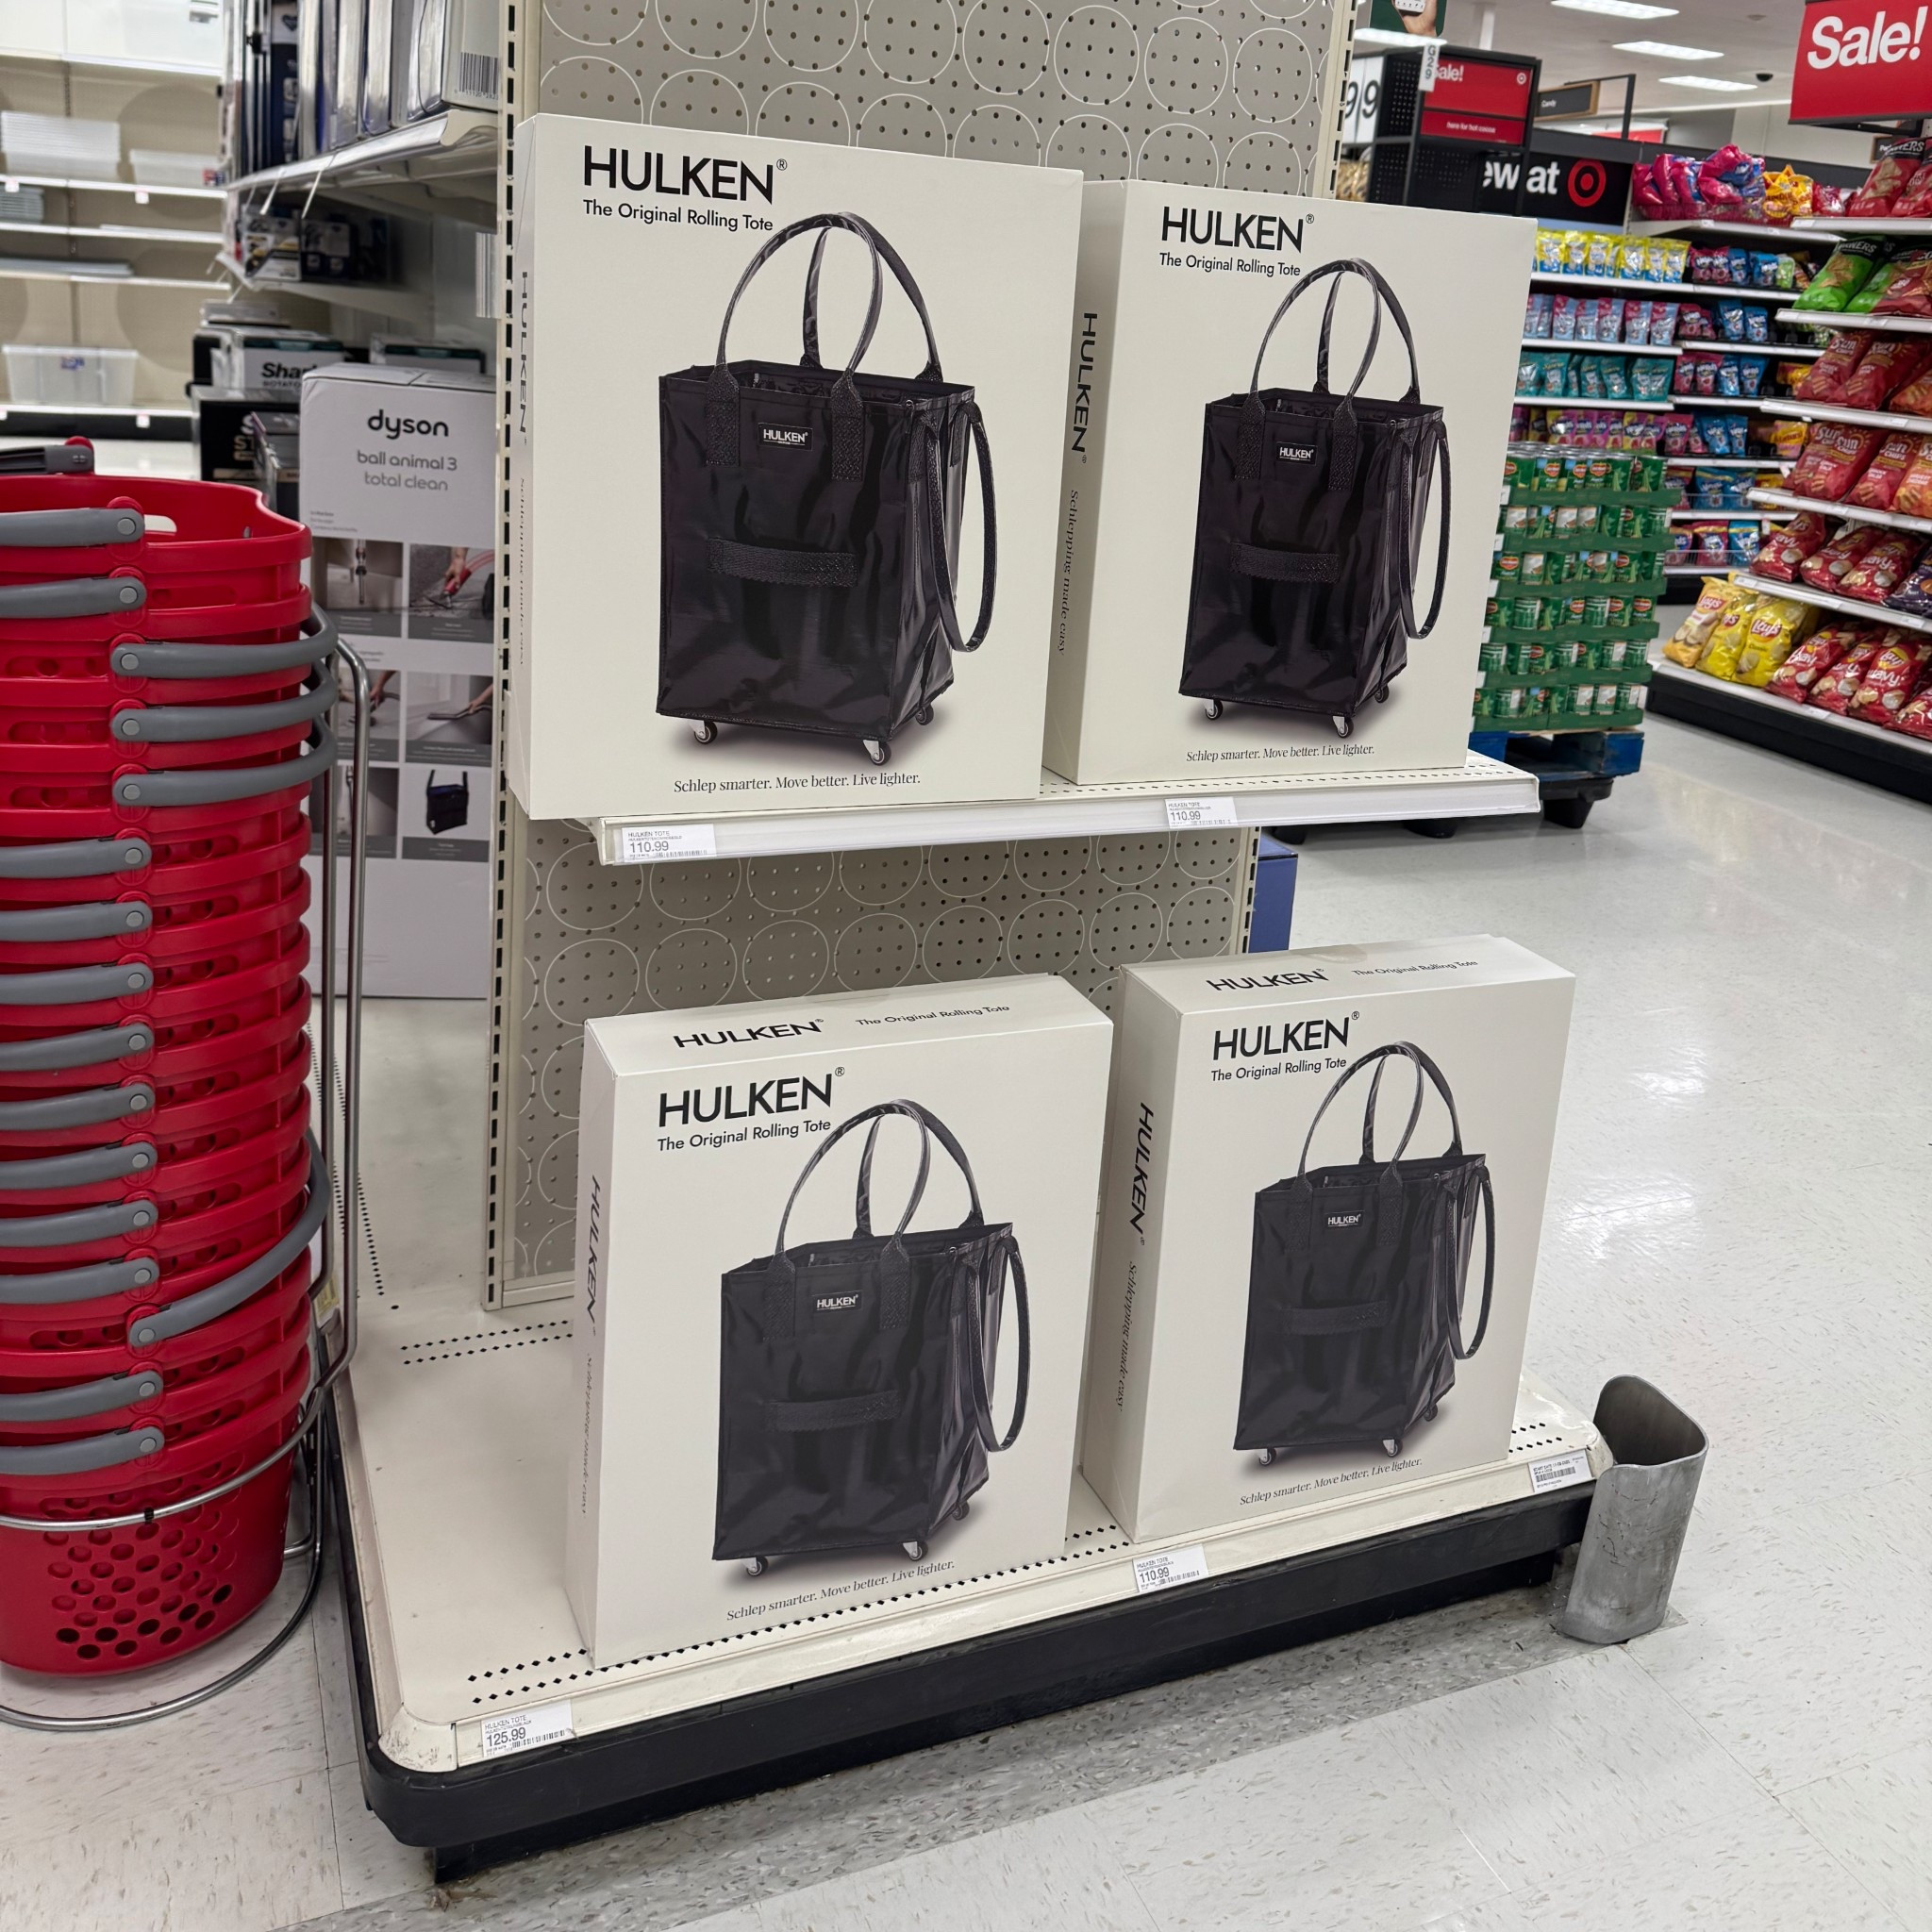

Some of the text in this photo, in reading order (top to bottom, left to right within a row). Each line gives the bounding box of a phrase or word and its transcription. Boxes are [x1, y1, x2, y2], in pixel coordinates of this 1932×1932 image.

[1807, 6, 1928, 70] Sale!
[1525, 160, 1560, 195] at
[583, 199, 774, 232] The Original Rolling Tote
[1159, 252, 1301, 277] The Original Rolling Tote
[367, 408, 450, 441] dyson
[357, 449, 458, 472] ball animal 3
[364, 472, 449, 491] total clean
[1063, 490, 1079, 575] Schlepping
[1060, 577, 1071, 620] made
[1186, 743, 1375, 763] Schlep smarter. Move better. Live lighter.
[674, 771, 921, 793] Schlep smarter. Move better. Live lighter.
[1170, 810, 1201, 822] 110.99
[629, 841, 669, 854] 110.99
[855, 1018, 881, 1026] The
[884, 1011, 937, 1024] Original
[939, 1007, 983, 1019] Rolling
[983, 1005, 1010, 1014] Tote
[1211, 1057, 1347, 1082] The Original Rolling Tote
[658, 1118, 831, 1152] The Original Rolling Tote
[1240, 1457, 1423, 1506] Schlep smarter. Move better. Live lighter.
[1139, 1566, 1170, 1584] 110.99
[726, 1559, 956, 1622] Schlep smarter. Move better. Live lighter.
[486, 1726, 526, 1747] 125.99
